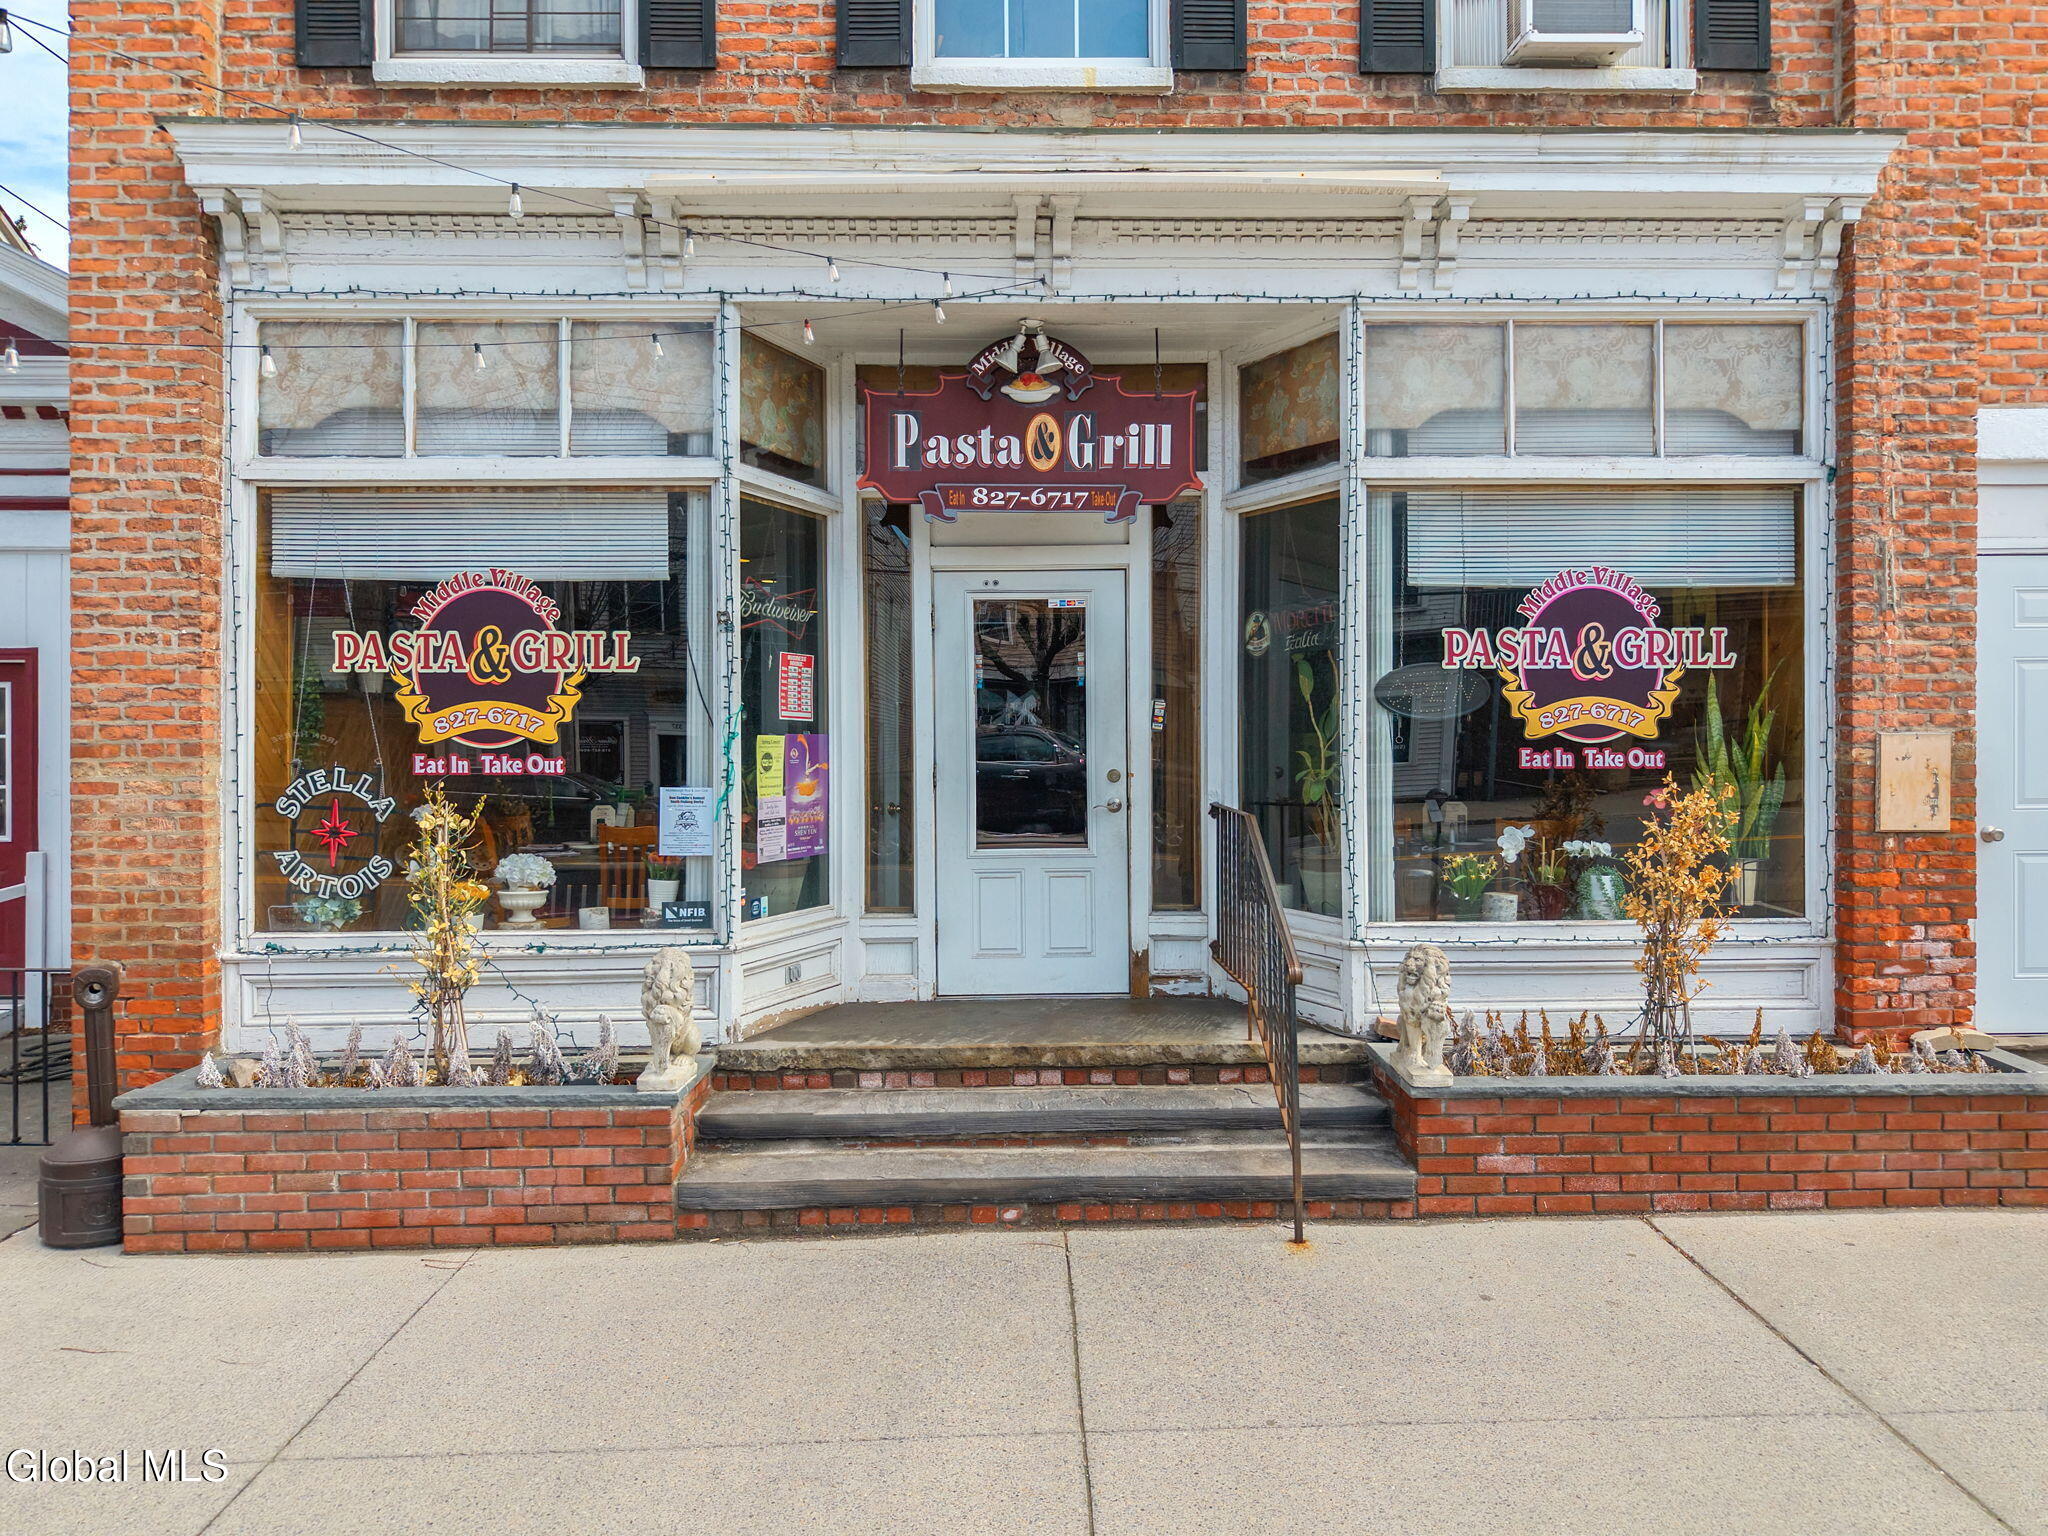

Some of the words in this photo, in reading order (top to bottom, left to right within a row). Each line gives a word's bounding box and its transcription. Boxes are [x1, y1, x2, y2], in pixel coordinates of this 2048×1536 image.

[893, 413, 1024, 469] Pasta
[1030, 421, 1056, 461] &
[1067, 413, 1173, 470] Grill
[949, 490, 960, 505] Eat
[960, 491, 966, 505] In
[972, 487, 1090, 509] 827-6717
[1090, 491, 1105, 507] Take
[1105, 491, 1117, 507] Out
[410, 570, 484, 623] Middle
[489, 568, 562, 623] Village
[740, 589, 814, 623] Budweiser
[1516, 568, 1588, 620] Middle
[1591, 566, 1661, 620] Village
[332, 630, 469, 673] PASTA
[467, 624, 512, 685] &
[510, 630, 641, 673] GRILL
[1442, 627, 1573, 669] PASTA
[1572, 621, 1614, 681] &
[1612, 627, 1737, 669] GRILL
[433, 708, 545, 734] 827-6717
[1539, 703, 1646, 730] 827-6717
[412, 754, 446, 775] Eat
[449, 754, 469, 775] In
[481, 754, 524, 774] Take
[526, 754, 566, 775] Out
[1519, 748, 1551, 770] Eat
[1553, 748, 1575, 770] In
[1582, 748, 1625, 769] Take
[1627, 748, 1666, 770] Out
[275, 767, 396, 823] STELLA
[273, 850, 393, 899] ARTOIS
[679, 907, 706, 917] NFIB
